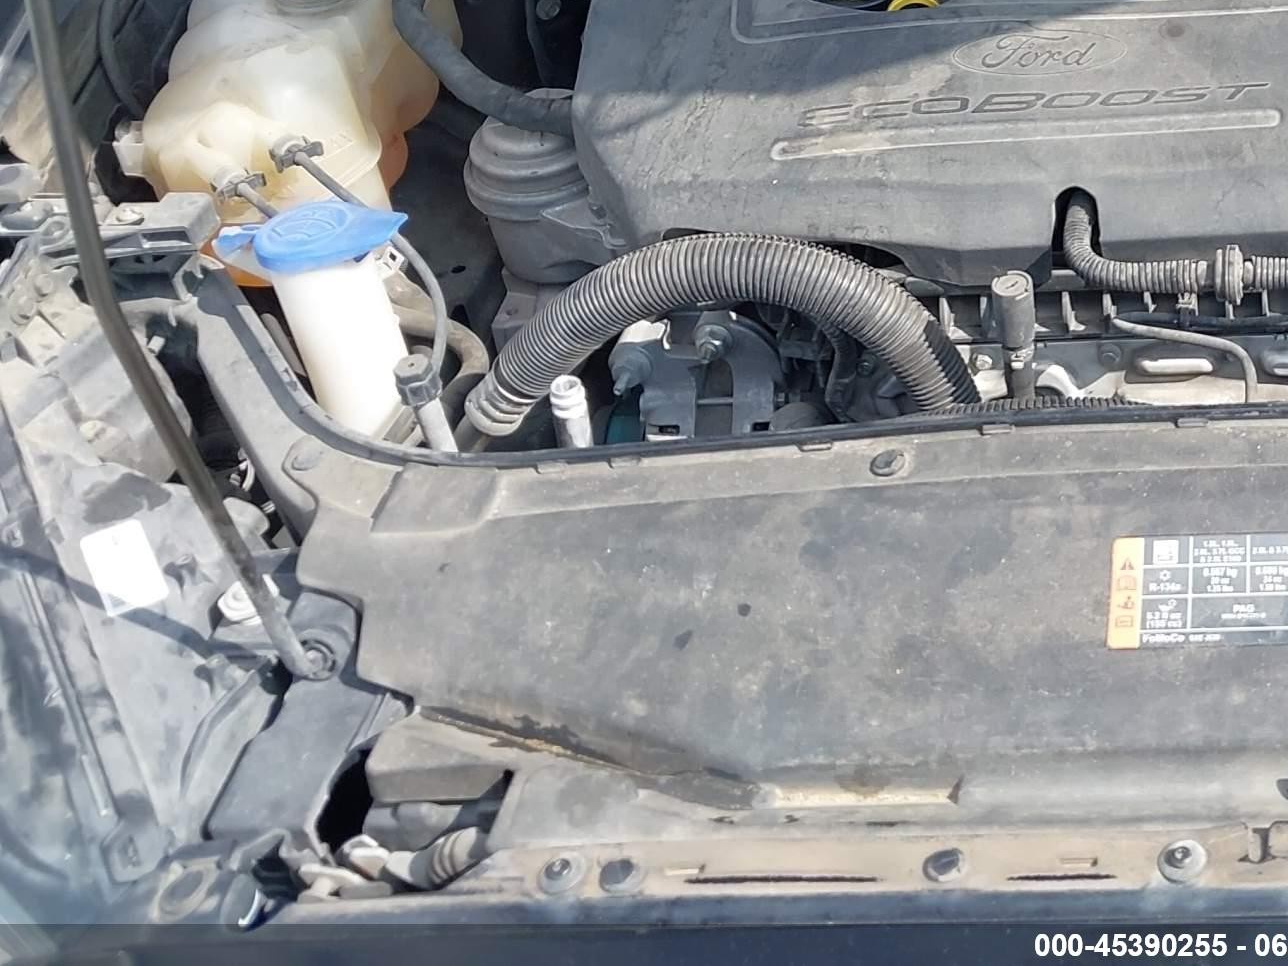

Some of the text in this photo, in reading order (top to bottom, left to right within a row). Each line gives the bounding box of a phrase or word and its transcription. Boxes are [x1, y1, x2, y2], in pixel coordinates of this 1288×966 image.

[982, 34, 1096, 68] Ford
[797, 81, 1271, 129] ECOBOOST
[1148, 582, 1182, 592] R-134a
[1232, 604, 1255, 613] PAG
[1142, 633, 1185, 643] FoMoCo
